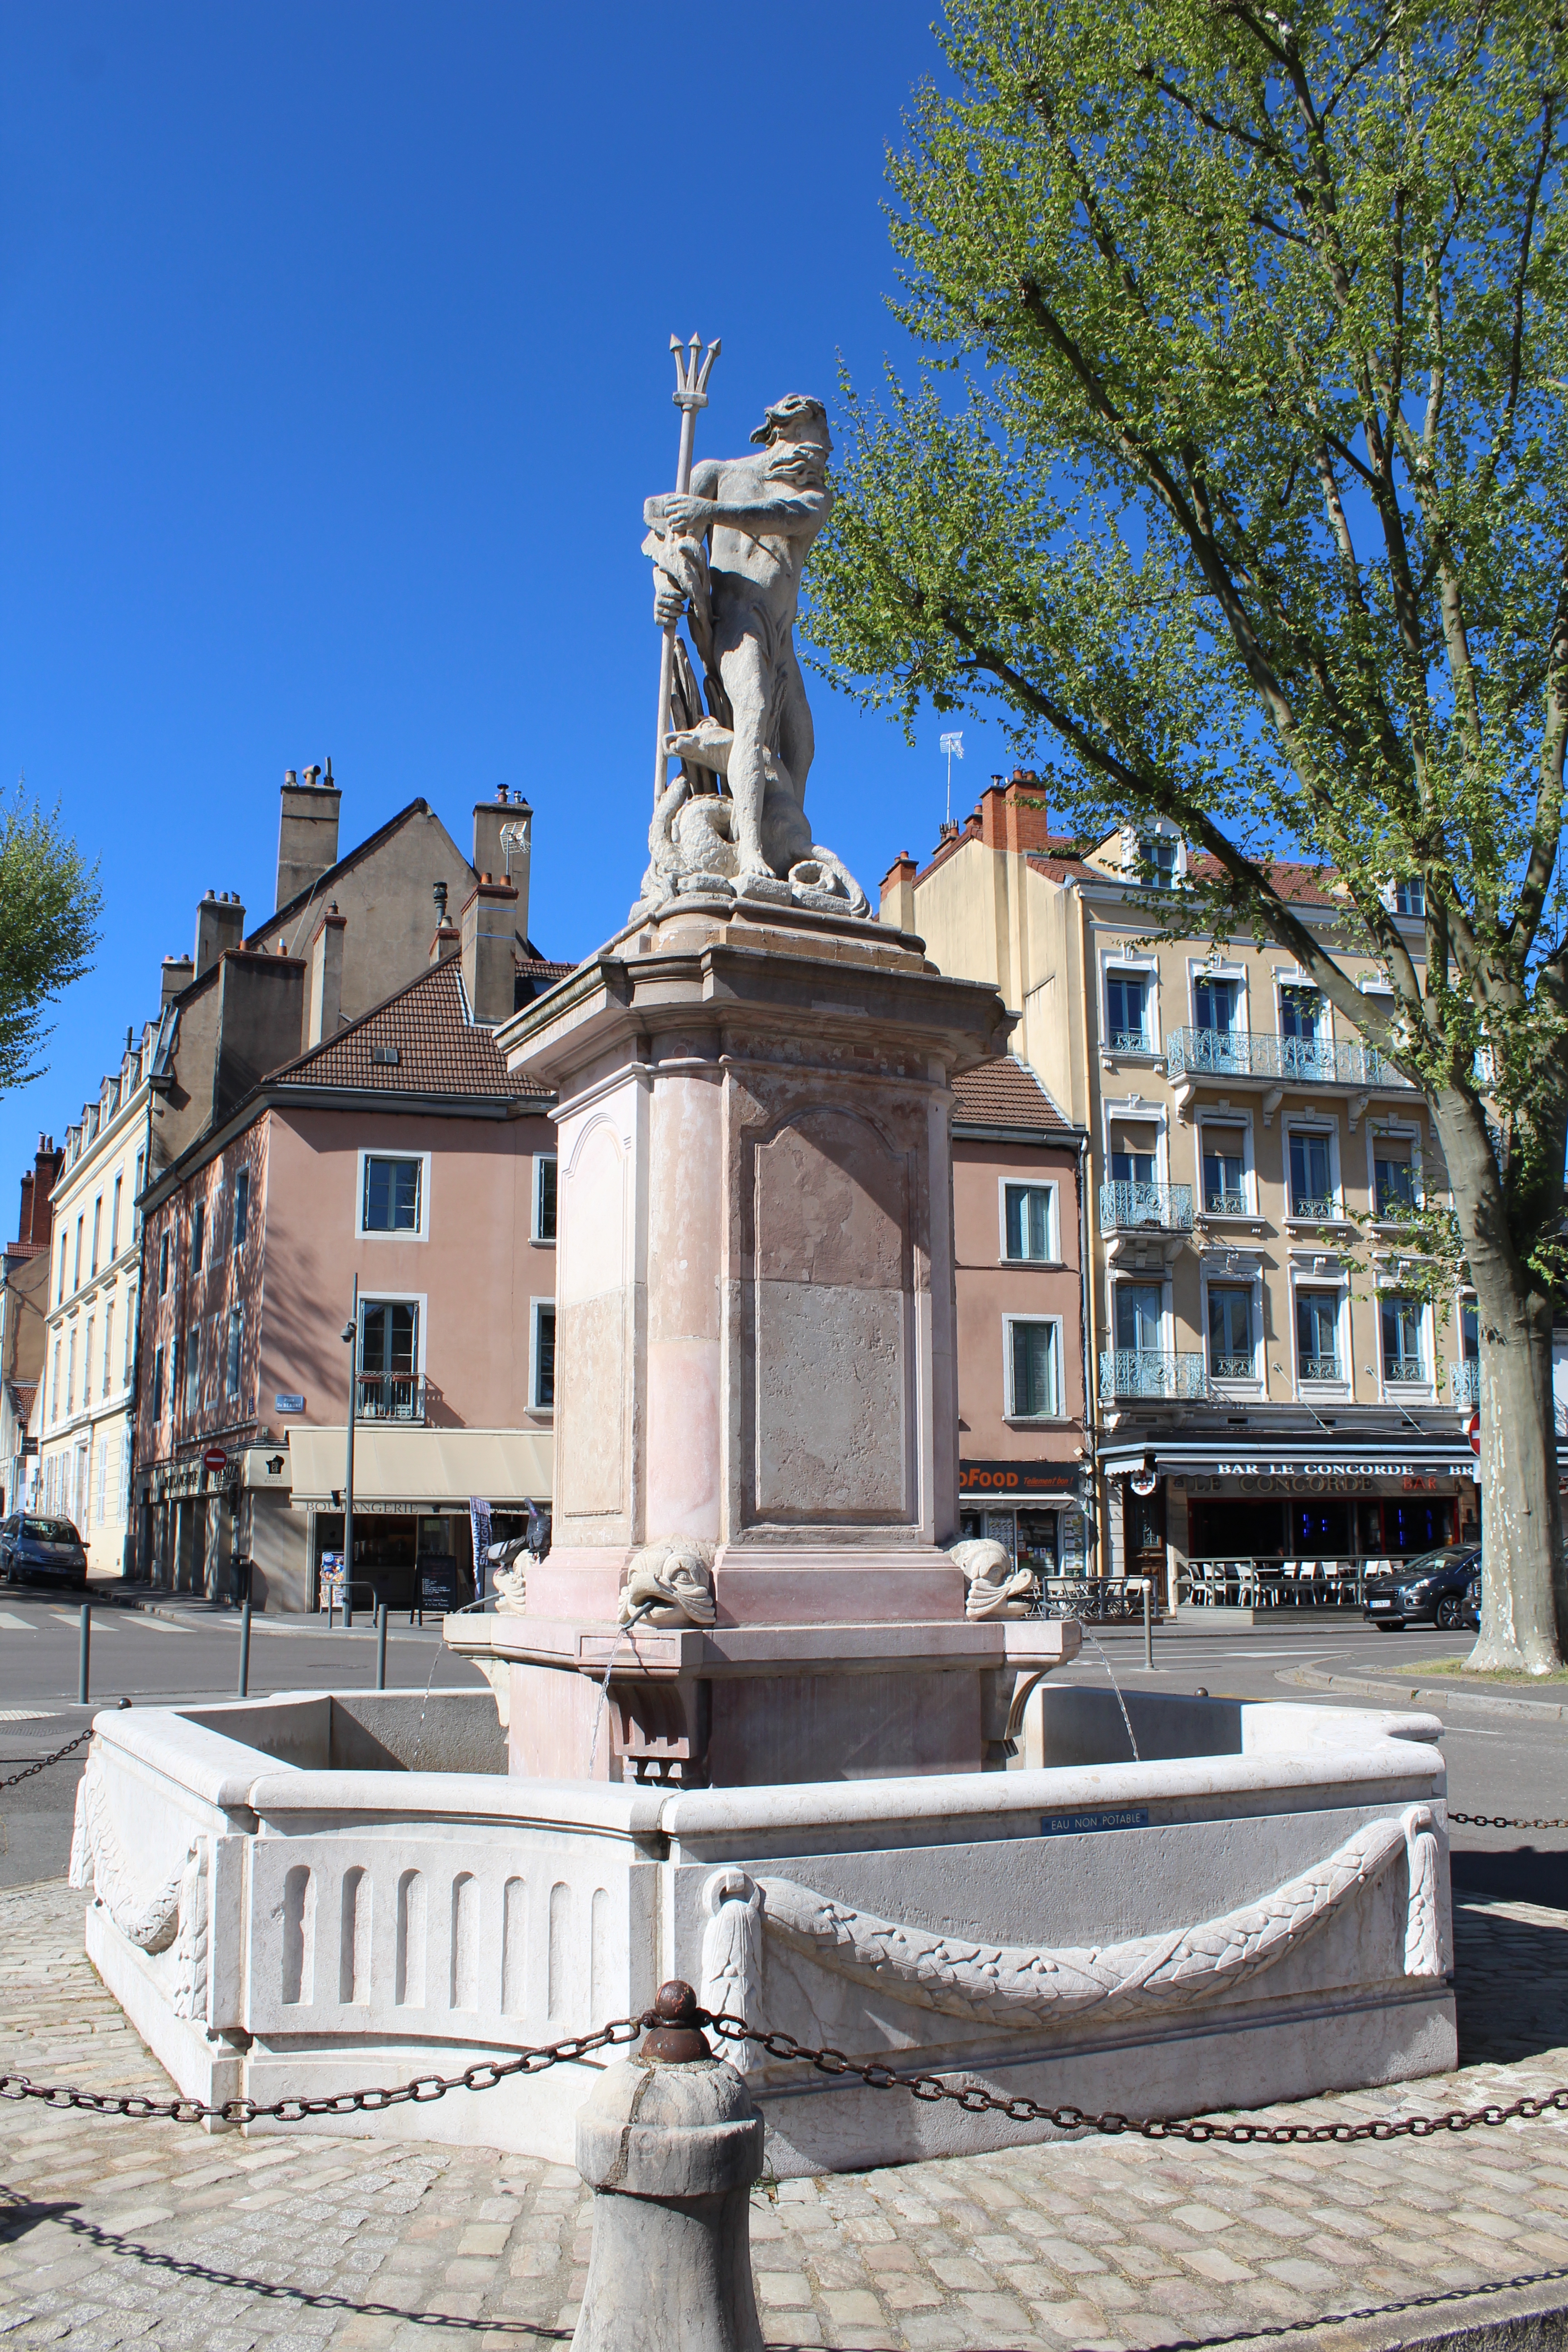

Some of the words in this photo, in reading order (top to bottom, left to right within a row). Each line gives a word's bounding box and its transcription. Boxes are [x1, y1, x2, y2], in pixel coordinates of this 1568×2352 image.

[1218, 1464, 1259, 1474] BAR
[1269, 1464, 1294, 1474] LE
[1303, 1465, 1414, 1475] CONCORDE
[1024, 1476, 1056, 1485] Tellement
[1191, 1476, 1222, 1491] LE
[1238, 1475, 1373, 1492] CONCORDE
[1403, 1476, 1436, 1490] BAR
[1052, 1820, 1069, 1830] EAU
[1075, 1818, 1097, 1828] NON
[1102, 1813, 1140, 1826] POTABLE
